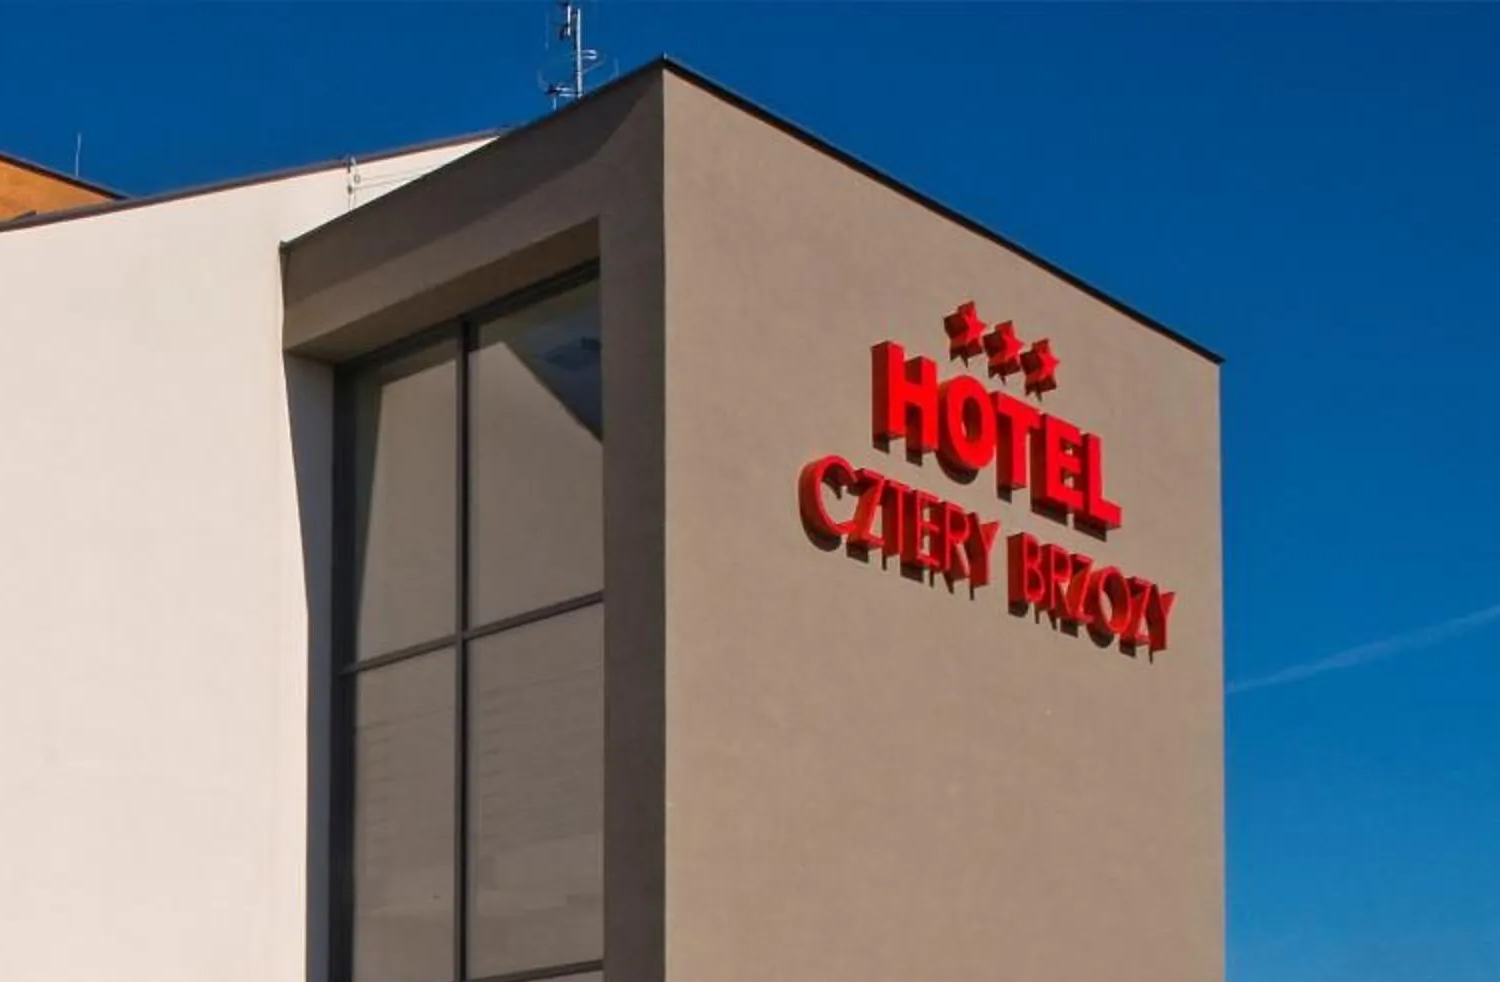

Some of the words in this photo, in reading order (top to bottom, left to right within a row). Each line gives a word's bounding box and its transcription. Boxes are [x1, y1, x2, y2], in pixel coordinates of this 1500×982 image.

[871, 340, 1122, 531] HOTEL
[798, 455, 1000, 590] CZTERY
[1007, 532, 1176, 654] BRZOZY
